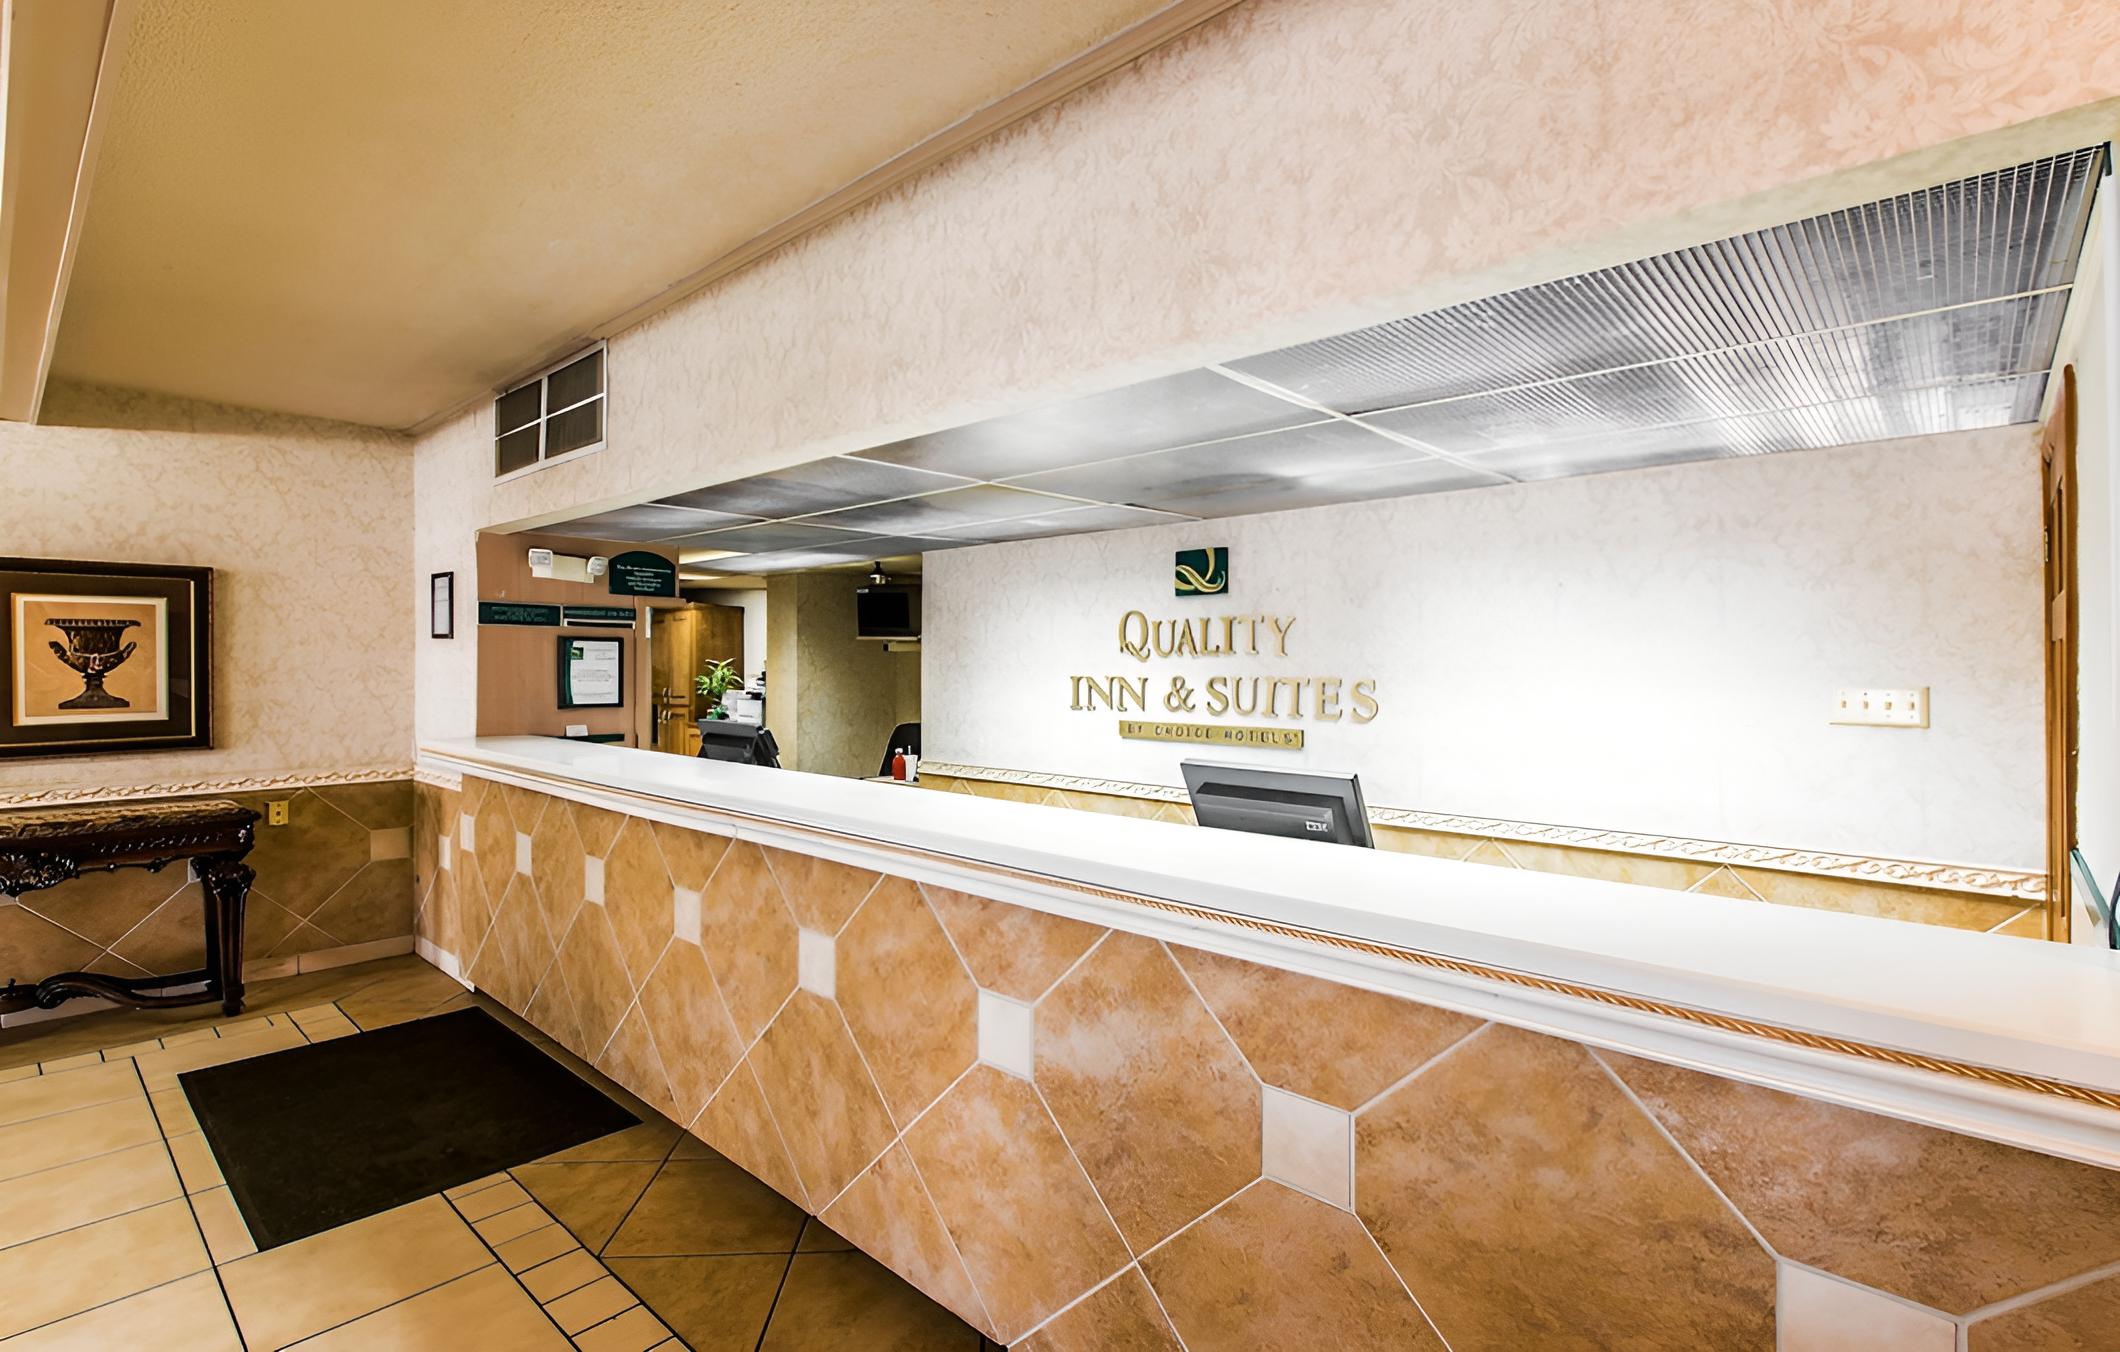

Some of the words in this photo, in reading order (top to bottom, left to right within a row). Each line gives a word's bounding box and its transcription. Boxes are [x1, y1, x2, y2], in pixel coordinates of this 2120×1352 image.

[1119, 610, 1296, 662] QUALITY
[1070, 675, 1148, 713] INN
[1164, 675, 1196, 713] &
[1206, 676, 1379, 724] SUITES
